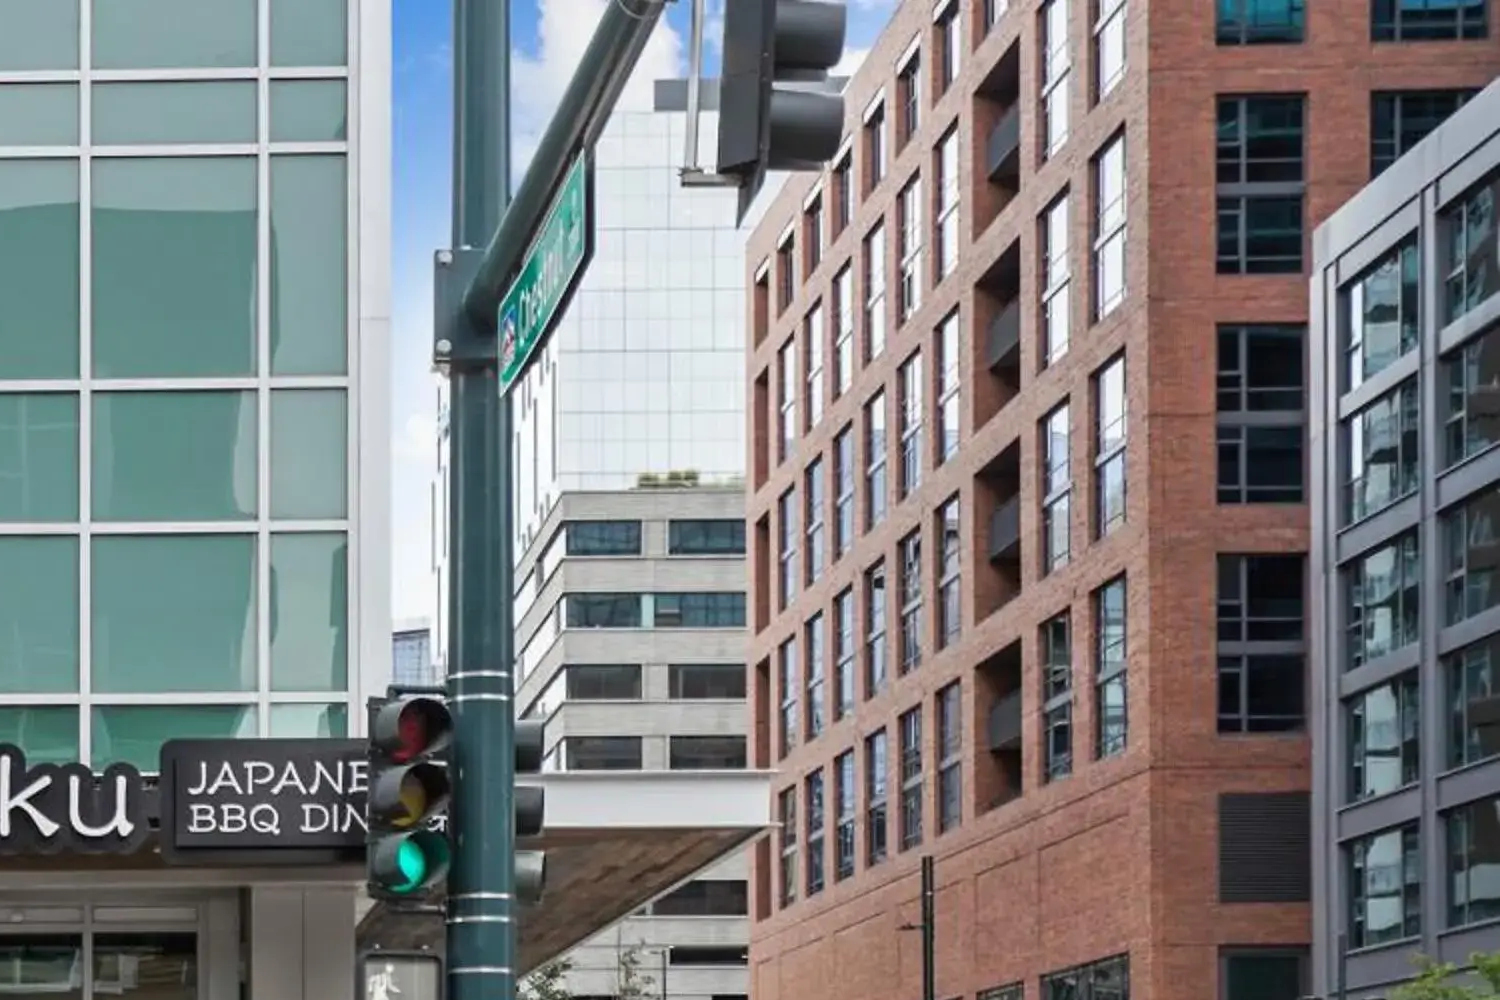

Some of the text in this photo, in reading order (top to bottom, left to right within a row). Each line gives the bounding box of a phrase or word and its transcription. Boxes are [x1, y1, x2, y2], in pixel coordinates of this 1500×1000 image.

[187, 760, 448, 795] JAPANE
[187, 803, 448, 836] BBQ DIN
